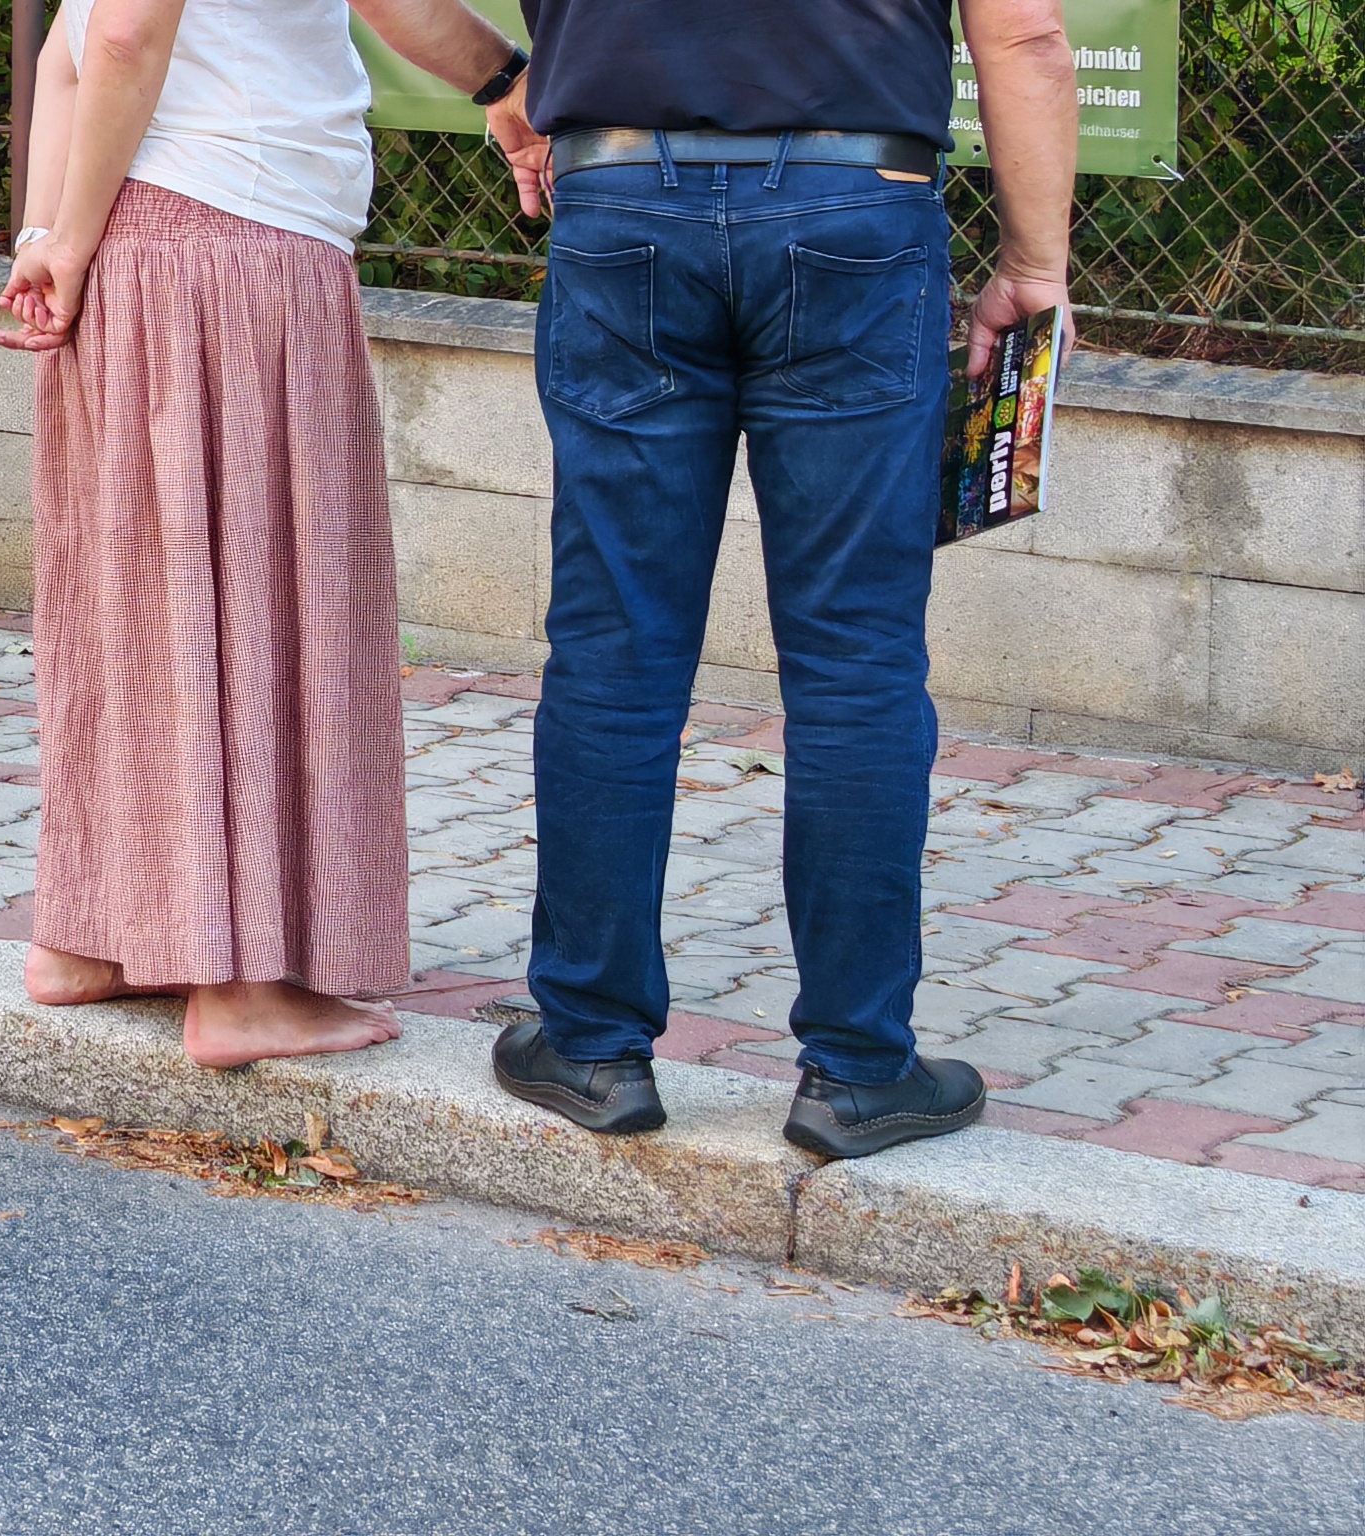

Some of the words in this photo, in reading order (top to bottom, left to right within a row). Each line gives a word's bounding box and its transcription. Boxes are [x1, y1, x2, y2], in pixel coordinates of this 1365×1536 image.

[1072, 44, 1142, 71] ybníků
[1076, 85, 1141, 108] eichen
[988, 430, 1013, 515] perly
